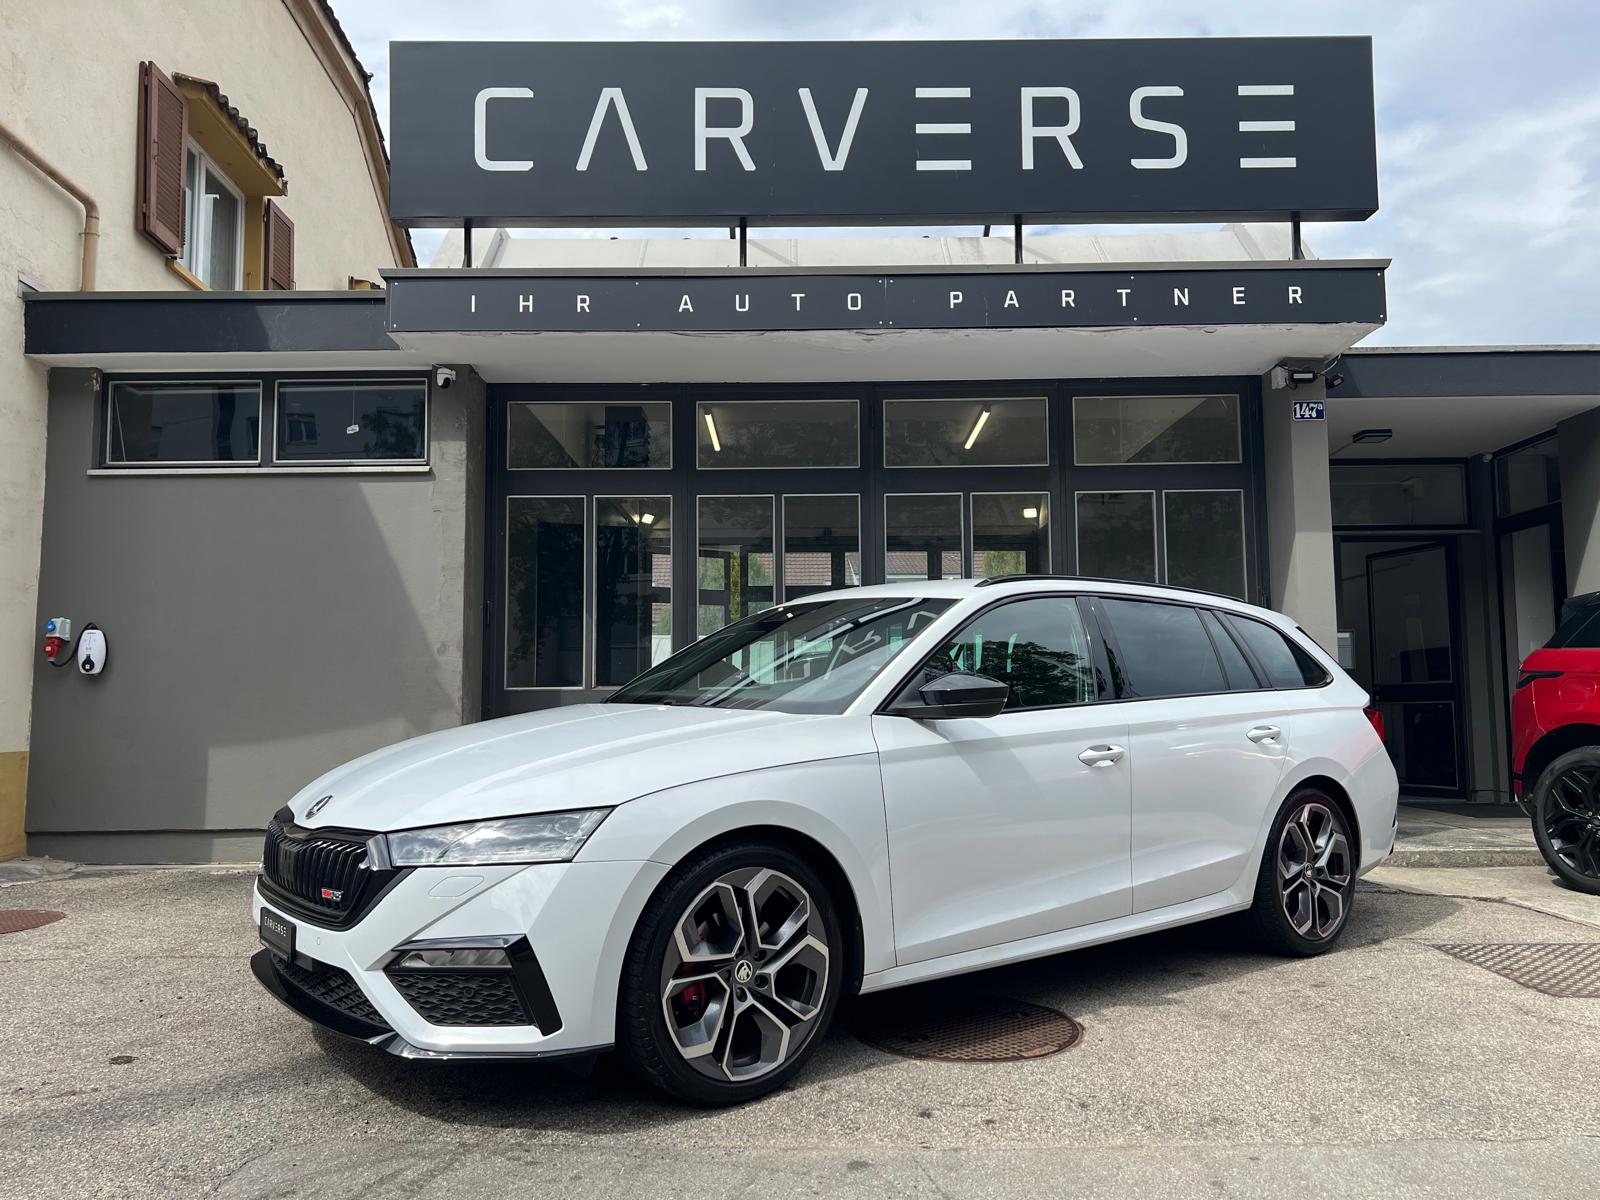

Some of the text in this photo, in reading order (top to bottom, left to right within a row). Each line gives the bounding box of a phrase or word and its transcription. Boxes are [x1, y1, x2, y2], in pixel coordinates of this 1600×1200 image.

[475, 85, 1296, 171] CARVERSE
[471, 286, 1303, 313] IHR AUTO PARTNER
[264, 916, 287, 937] CARVERSE
